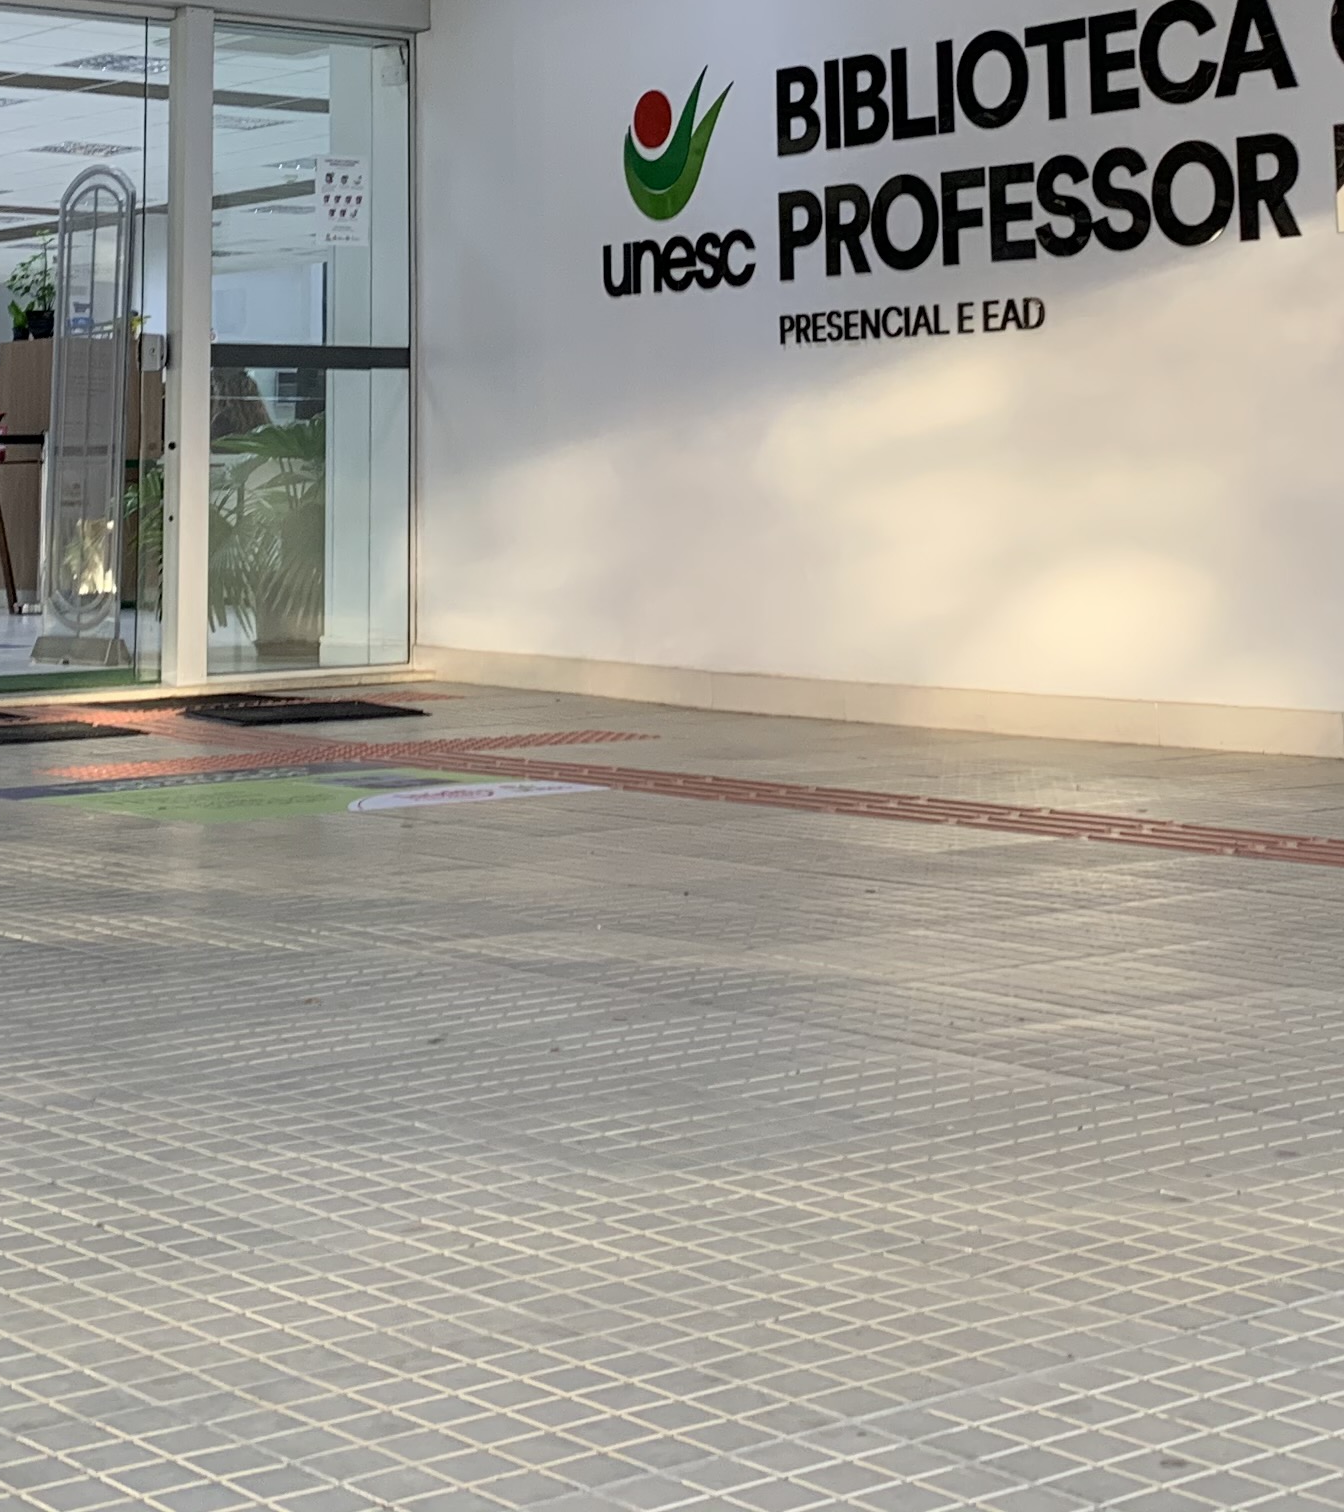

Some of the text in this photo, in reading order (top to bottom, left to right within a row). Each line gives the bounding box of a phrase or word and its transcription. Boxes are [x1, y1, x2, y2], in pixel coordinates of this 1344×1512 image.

[777, 131, 1303, 283] PROFESSOR
[602, 228, 757, 297] unesc
[779, 296, 1046, 345] PRESENCIAL E EAD
